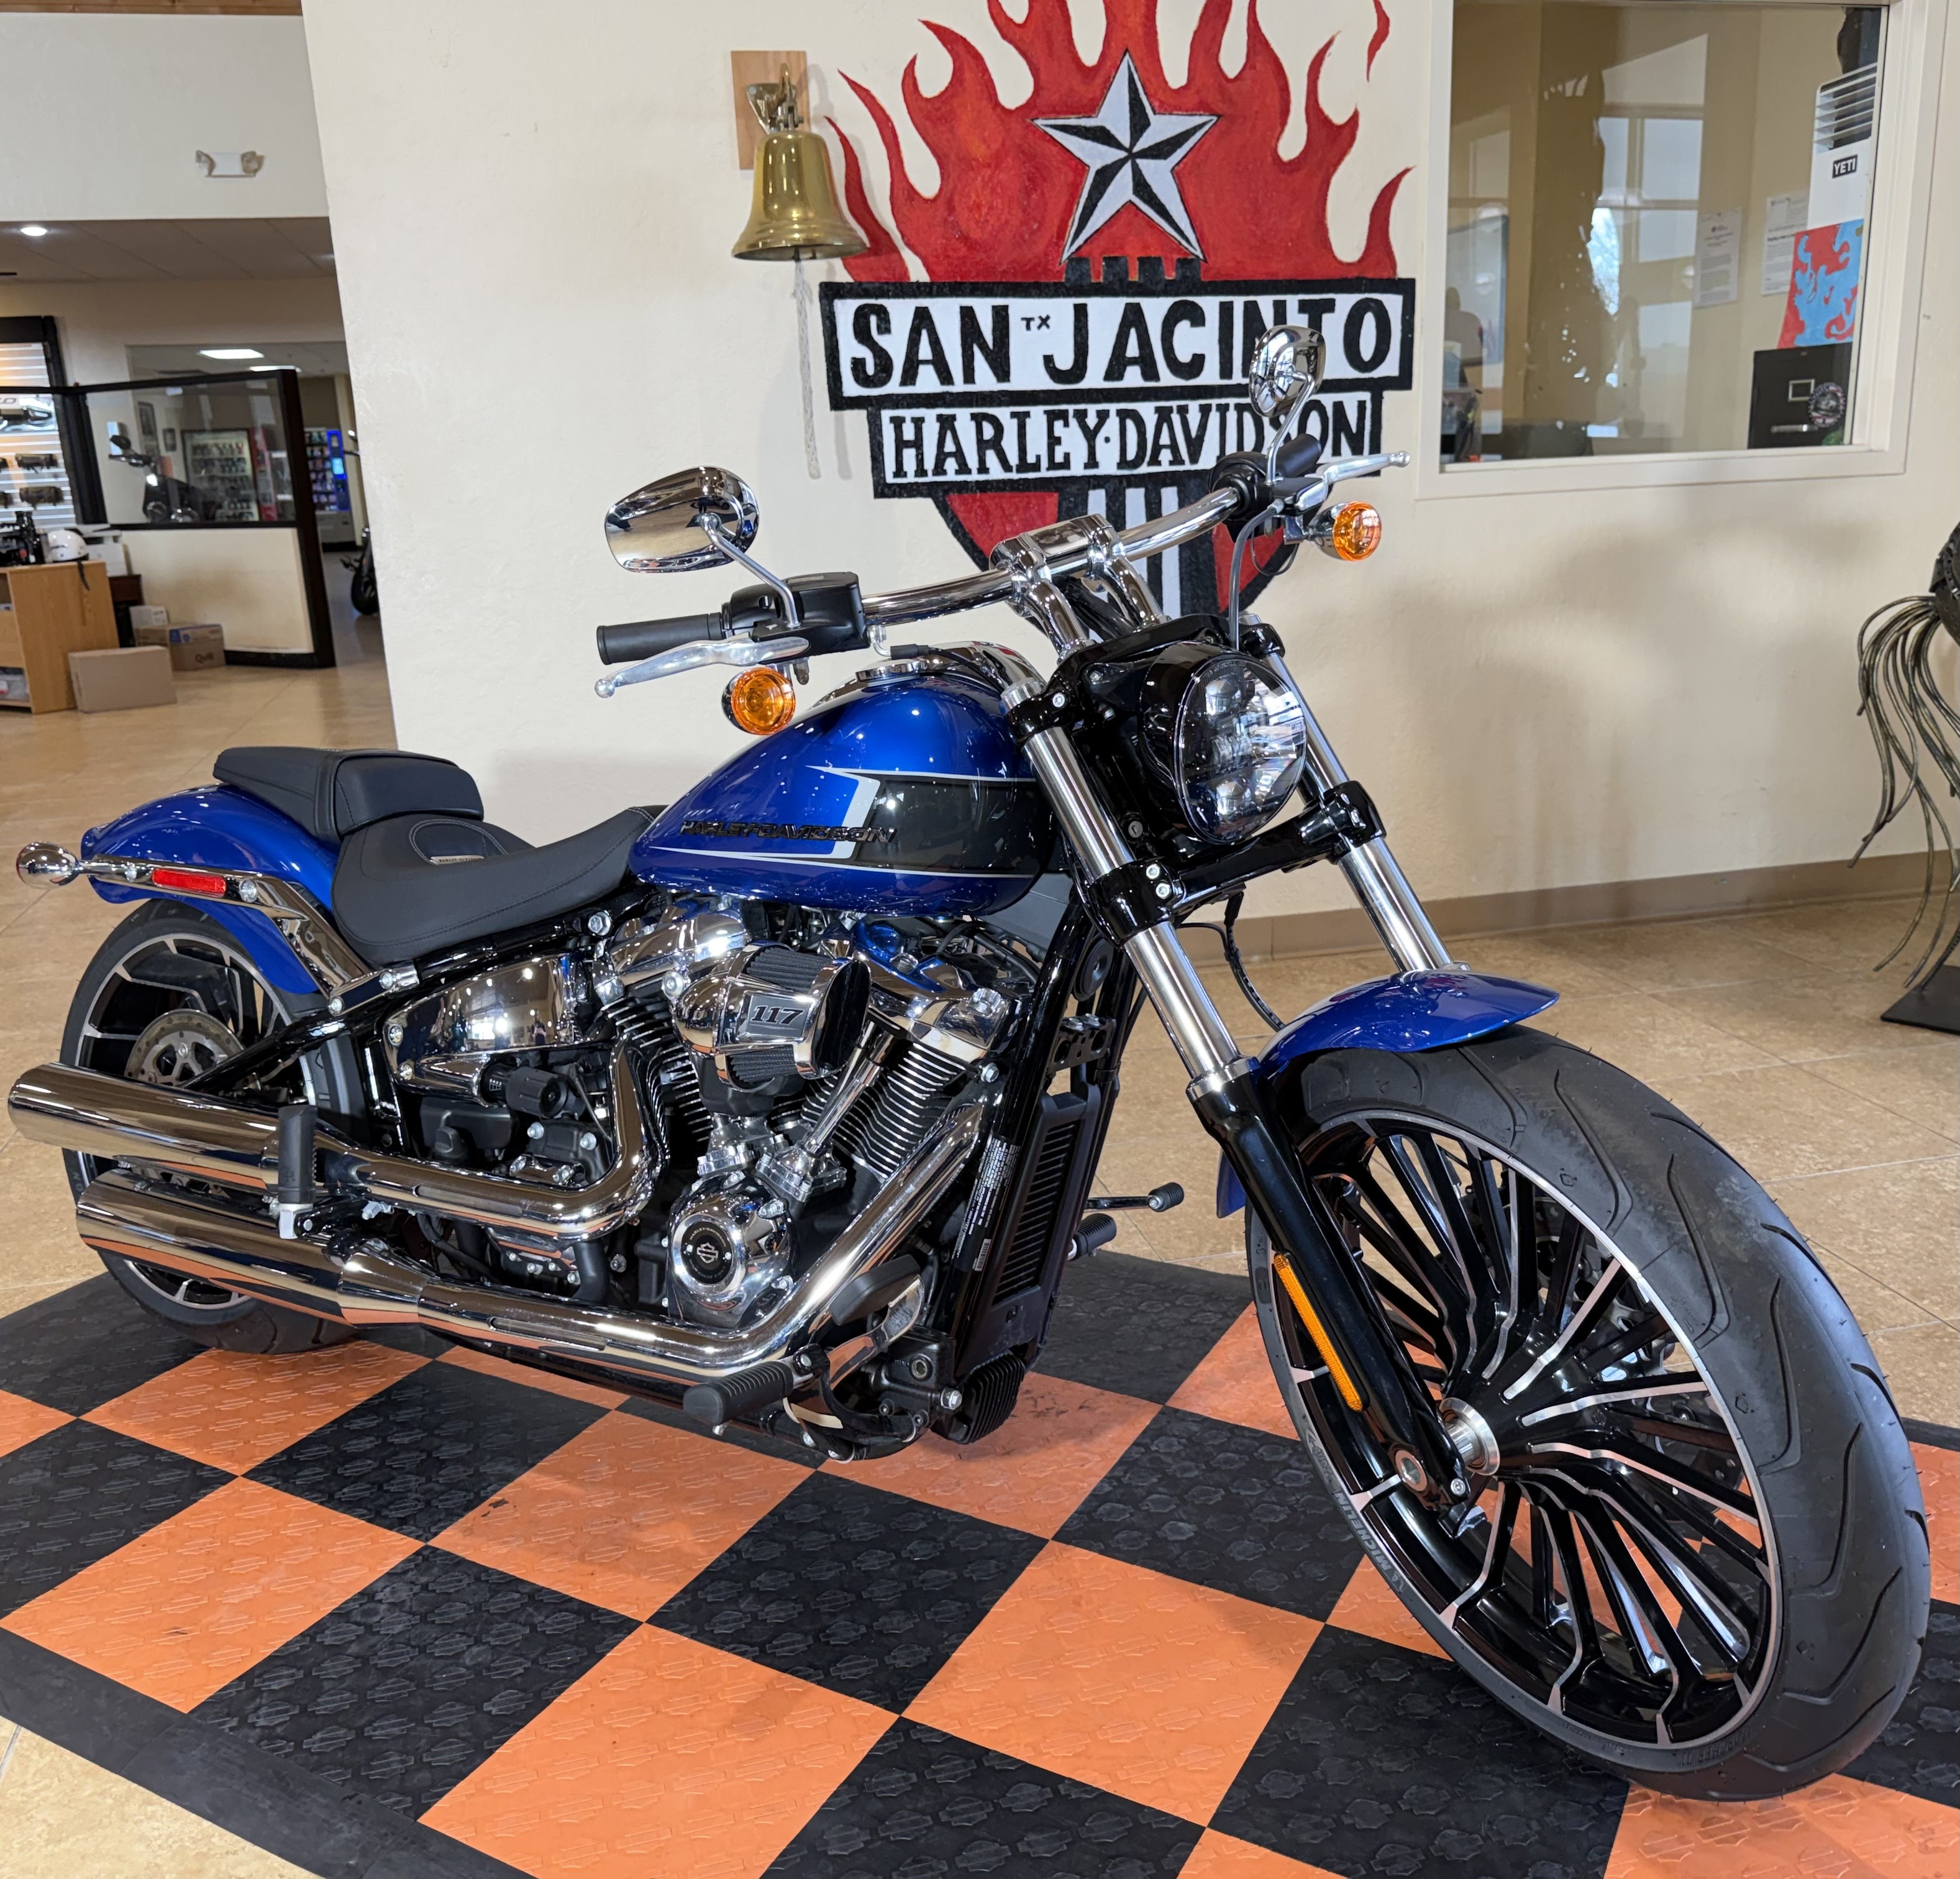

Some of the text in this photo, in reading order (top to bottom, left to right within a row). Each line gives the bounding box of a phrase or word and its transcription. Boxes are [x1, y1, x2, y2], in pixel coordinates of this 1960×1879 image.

[1834, 158, 1856, 175] YETI
[850, 303, 1011, 387] SAN
[1021, 314, 1051, 331] TX
[680, 821, 897, 843] HARLEY-DAVIDSON
[750, 1005, 805, 1025] 117
[1335, 1493, 1392, 1570] MICHELIN
